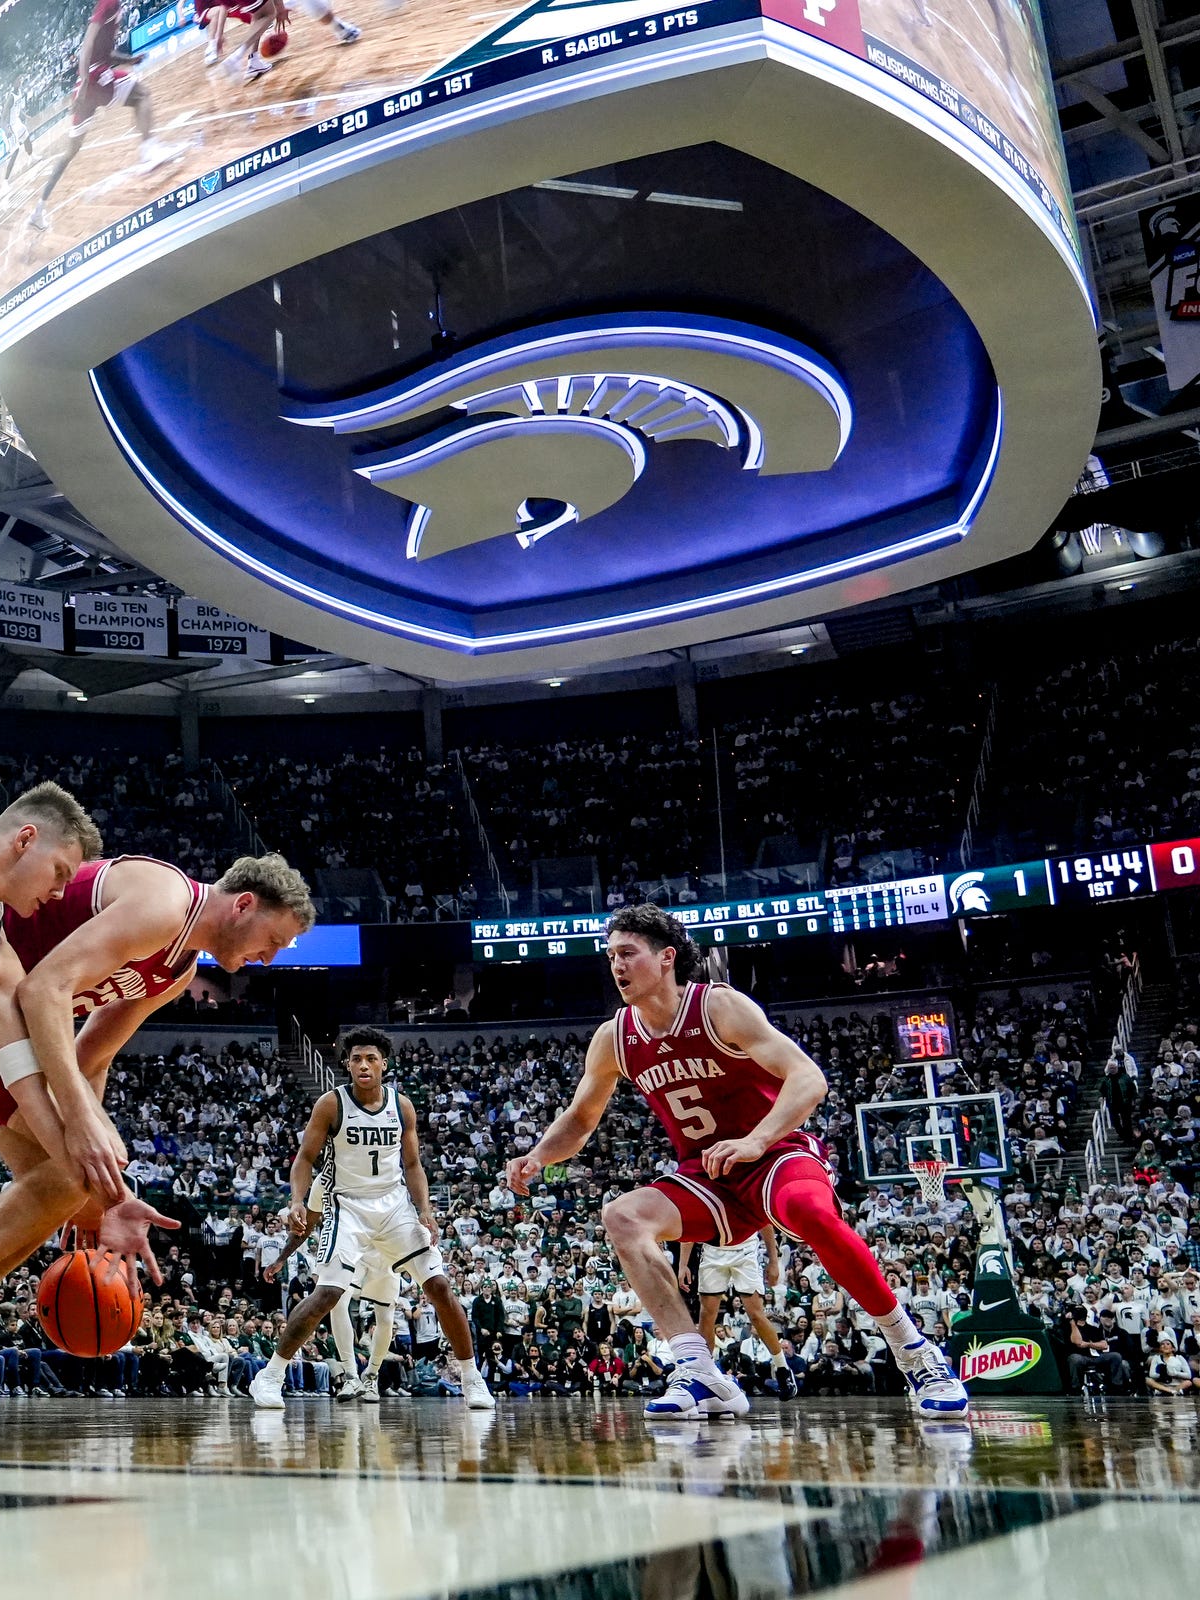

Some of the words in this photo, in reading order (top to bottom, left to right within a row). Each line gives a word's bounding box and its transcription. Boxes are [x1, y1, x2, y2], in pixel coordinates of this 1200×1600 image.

[542, 49, 559, 64] R.
[564, 29, 622, 58] SABOL
[645, 21, 657, 36] 3
[664, 10, 698, 31] PTS
[867, 45, 959, 116] MSUSPARTANS.COM
[976, 115, 1001, 150] KENT
[1003, 140, 1030, 180] STATE
[84, 231, 112, 258] KENT
[115, 208, 154, 240] STATE
[176, 184, 198, 208] 30
[226, 141, 291, 182] BUFFALO
[318, 118, 338, 133] 13-3
[342, 110, 368, 134] 20
[383, 90, 422, 117] 6:00
[444, 72, 473, 96] 1ST
[19, 592, 45, 606] TEN
[94, 602, 118, 612] BIG
[121, 602, 148, 614] TEN
[197, 606, 220, 617] BIG
[2, 622, 38, 640] 1998
[78, 614, 165, 628] CHAMPIONS
[103, 633, 140, 648] 1990
[207, 638, 242, 652] 1979
[1058, 850, 1143, 884] 19:44
[1170, 846, 1196, 876] 0
[904, 884, 926, 896] FLS
[930, 882, 936, 892] 0
[1013, 870, 1027, 897] 1
[1087, 881, 1114, 898] 1ST
[474, 925, 500, 938] FG%
[505, 922, 538, 936] 3FG%
[543, 920, 568, 934] FT%
[704, 906, 730, 922] AST
[738, 902, 765, 918] BLK
[771, 900, 790, 914] TO
[796, 896, 824, 912] STL
[906, 904, 928, 916] TOL
[932, 902, 940, 912] 4
[484, 945, 494, 958] 0
[518, 944, 528, 957] 0
[548, 941, 566, 954] 50
[714, 928, 724, 942] 0
[748, 924, 758, 938] 0
[778, 922, 788, 936] 0
[807, 918, 818, 932] 0
[906, 1014, 945, 1029] 19:44
[910, 1031, 944, 1058] 30
[636, 1058, 726, 1095] INDIANA
[664, 1084, 718, 1140] 5
[346, 1126, 398, 1146] STATE
[368, 1150, 378, 1176] 1
[960, 1344, 1034, 1381] LIBMAN
